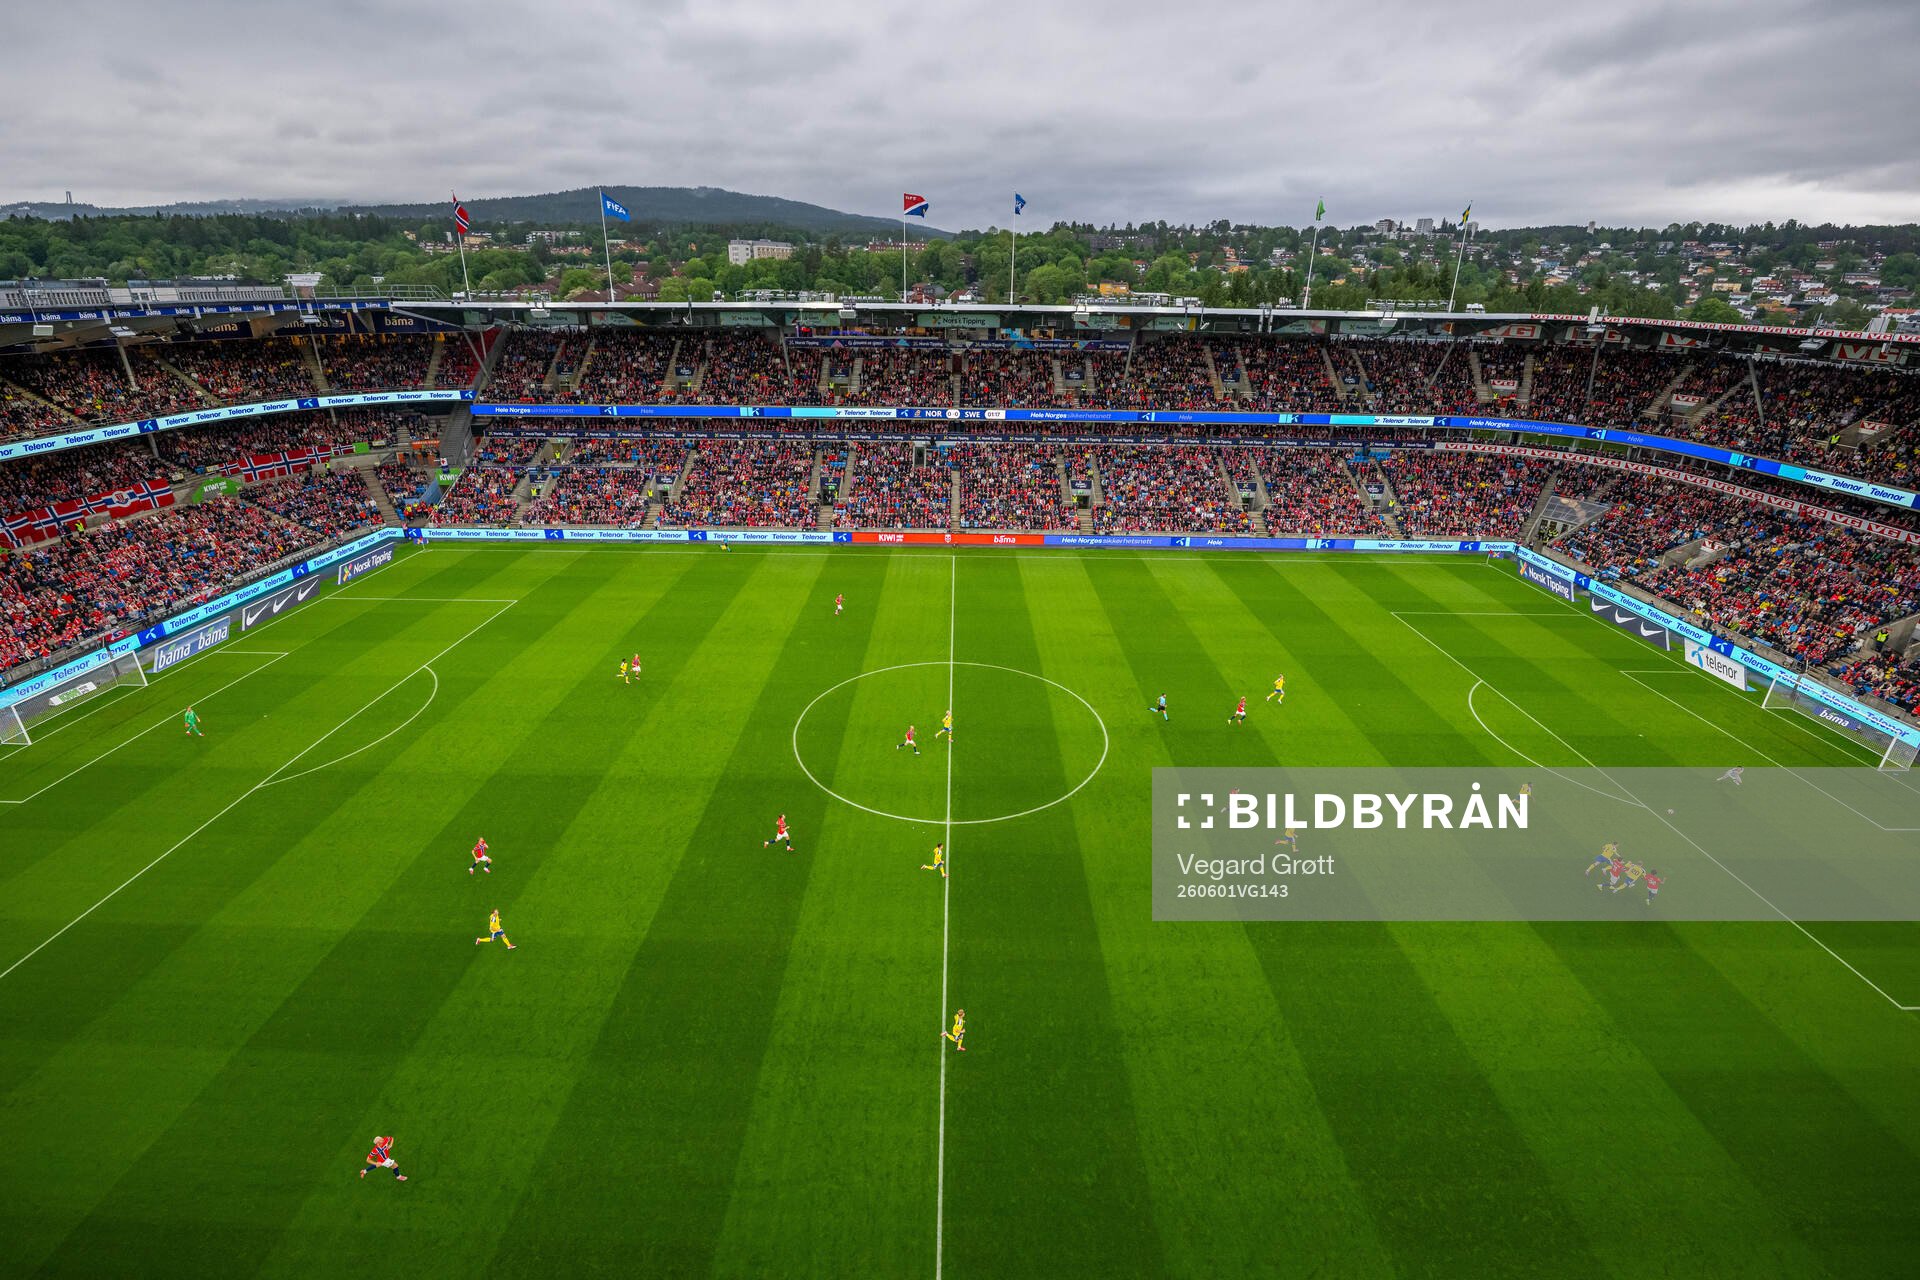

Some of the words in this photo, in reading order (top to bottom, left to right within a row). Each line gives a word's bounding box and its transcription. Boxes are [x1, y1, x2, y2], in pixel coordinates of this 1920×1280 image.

[606, 200, 626, 215] FIFA
[962, 317, 986, 326] Tipping
[1763, 326, 1782, 334] VG
[1815, 329, 1834, 337] VG
[1839, 331, 1862, 339] VG
[1865, 332, 1893, 341] VG
[328, 396, 354, 405] Telenor
[363, 394, 389, 403] Telenor
[397, 392, 422, 401] Telenor
[430, 391, 453, 399] Telenor
[165, 416, 190, 426] Telenor
[196, 410, 222, 421] Telenor
[228, 406, 254, 415] Telenor
[262, 402, 288, 411] Telenor
[925, 410, 942, 418] NOR
[1044, 412, 1067, 420] Norges
[1485, 420, 1510, 429] Norges
[23, 439, 56, 453] Telenor
[64, 433, 95, 445] Telenor
[103, 426, 130, 439] Telenor
[1627, 435, 1644, 443] Hele
[440, 473, 454, 481] KIWI
[204, 483, 219, 493] KIWI
[1501, 446, 1526, 454] VG
[1531, 448, 1557, 458] VG
[1562, 452, 1589, 462] VG
[1593, 457, 1620, 467] VG
[1625, 462, 1651, 473] VG
[1655, 467, 1680, 479] VG
[1683, 474, 1709, 486] VG
[1713, 481, 1736, 493] VG
[1739, 488, 1764, 500] VG
[1767, 494, 1794, 509] VG
[1798, 504, 1828, 518] VG
[1831, 513, 1862, 528] VG
[1867, 522, 1901, 539] VG
[1832, 478, 1863, 492] Telenor
[1871, 487, 1905, 502] Telenor
[802, 533, 827, 541] Telenor
[878, 534, 895, 542] KIWI
[1078, 537, 1102, 545] Norges
[313, 554, 333, 567] Telenor
[336, 544, 355, 557] Telenor
[357, 536, 376, 548] Telenor
[378, 529, 397, 538] Telenor
[354, 558, 372, 575] Norsk
[370, 549, 392, 567] Tipping
[1530, 553, 1548, 566] Telenor
[1551, 563, 1570, 577] Telenor
[1529, 567, 1545, 583] Norsk
[1544, 574, 1570, 599] Tipping
[169, 611, 200, 629] Telenor
[204, 598, 231, 614] Telenor
[235, 585, 260, 600] Telenor
[263, 573, 287, 588] Telenor
[1594, 583, 1616, 599] Telenor
[1619, 595, 1644, 611] Telenor
[1647, 608, 1673, 625] Telenor
[1676, 622, 1704, 640] Telenor
[52, 660, 90, 681] Telenor
[1706, 653, 1738, 681] telenor
[1740, 651, 1773, 673] Telenor
